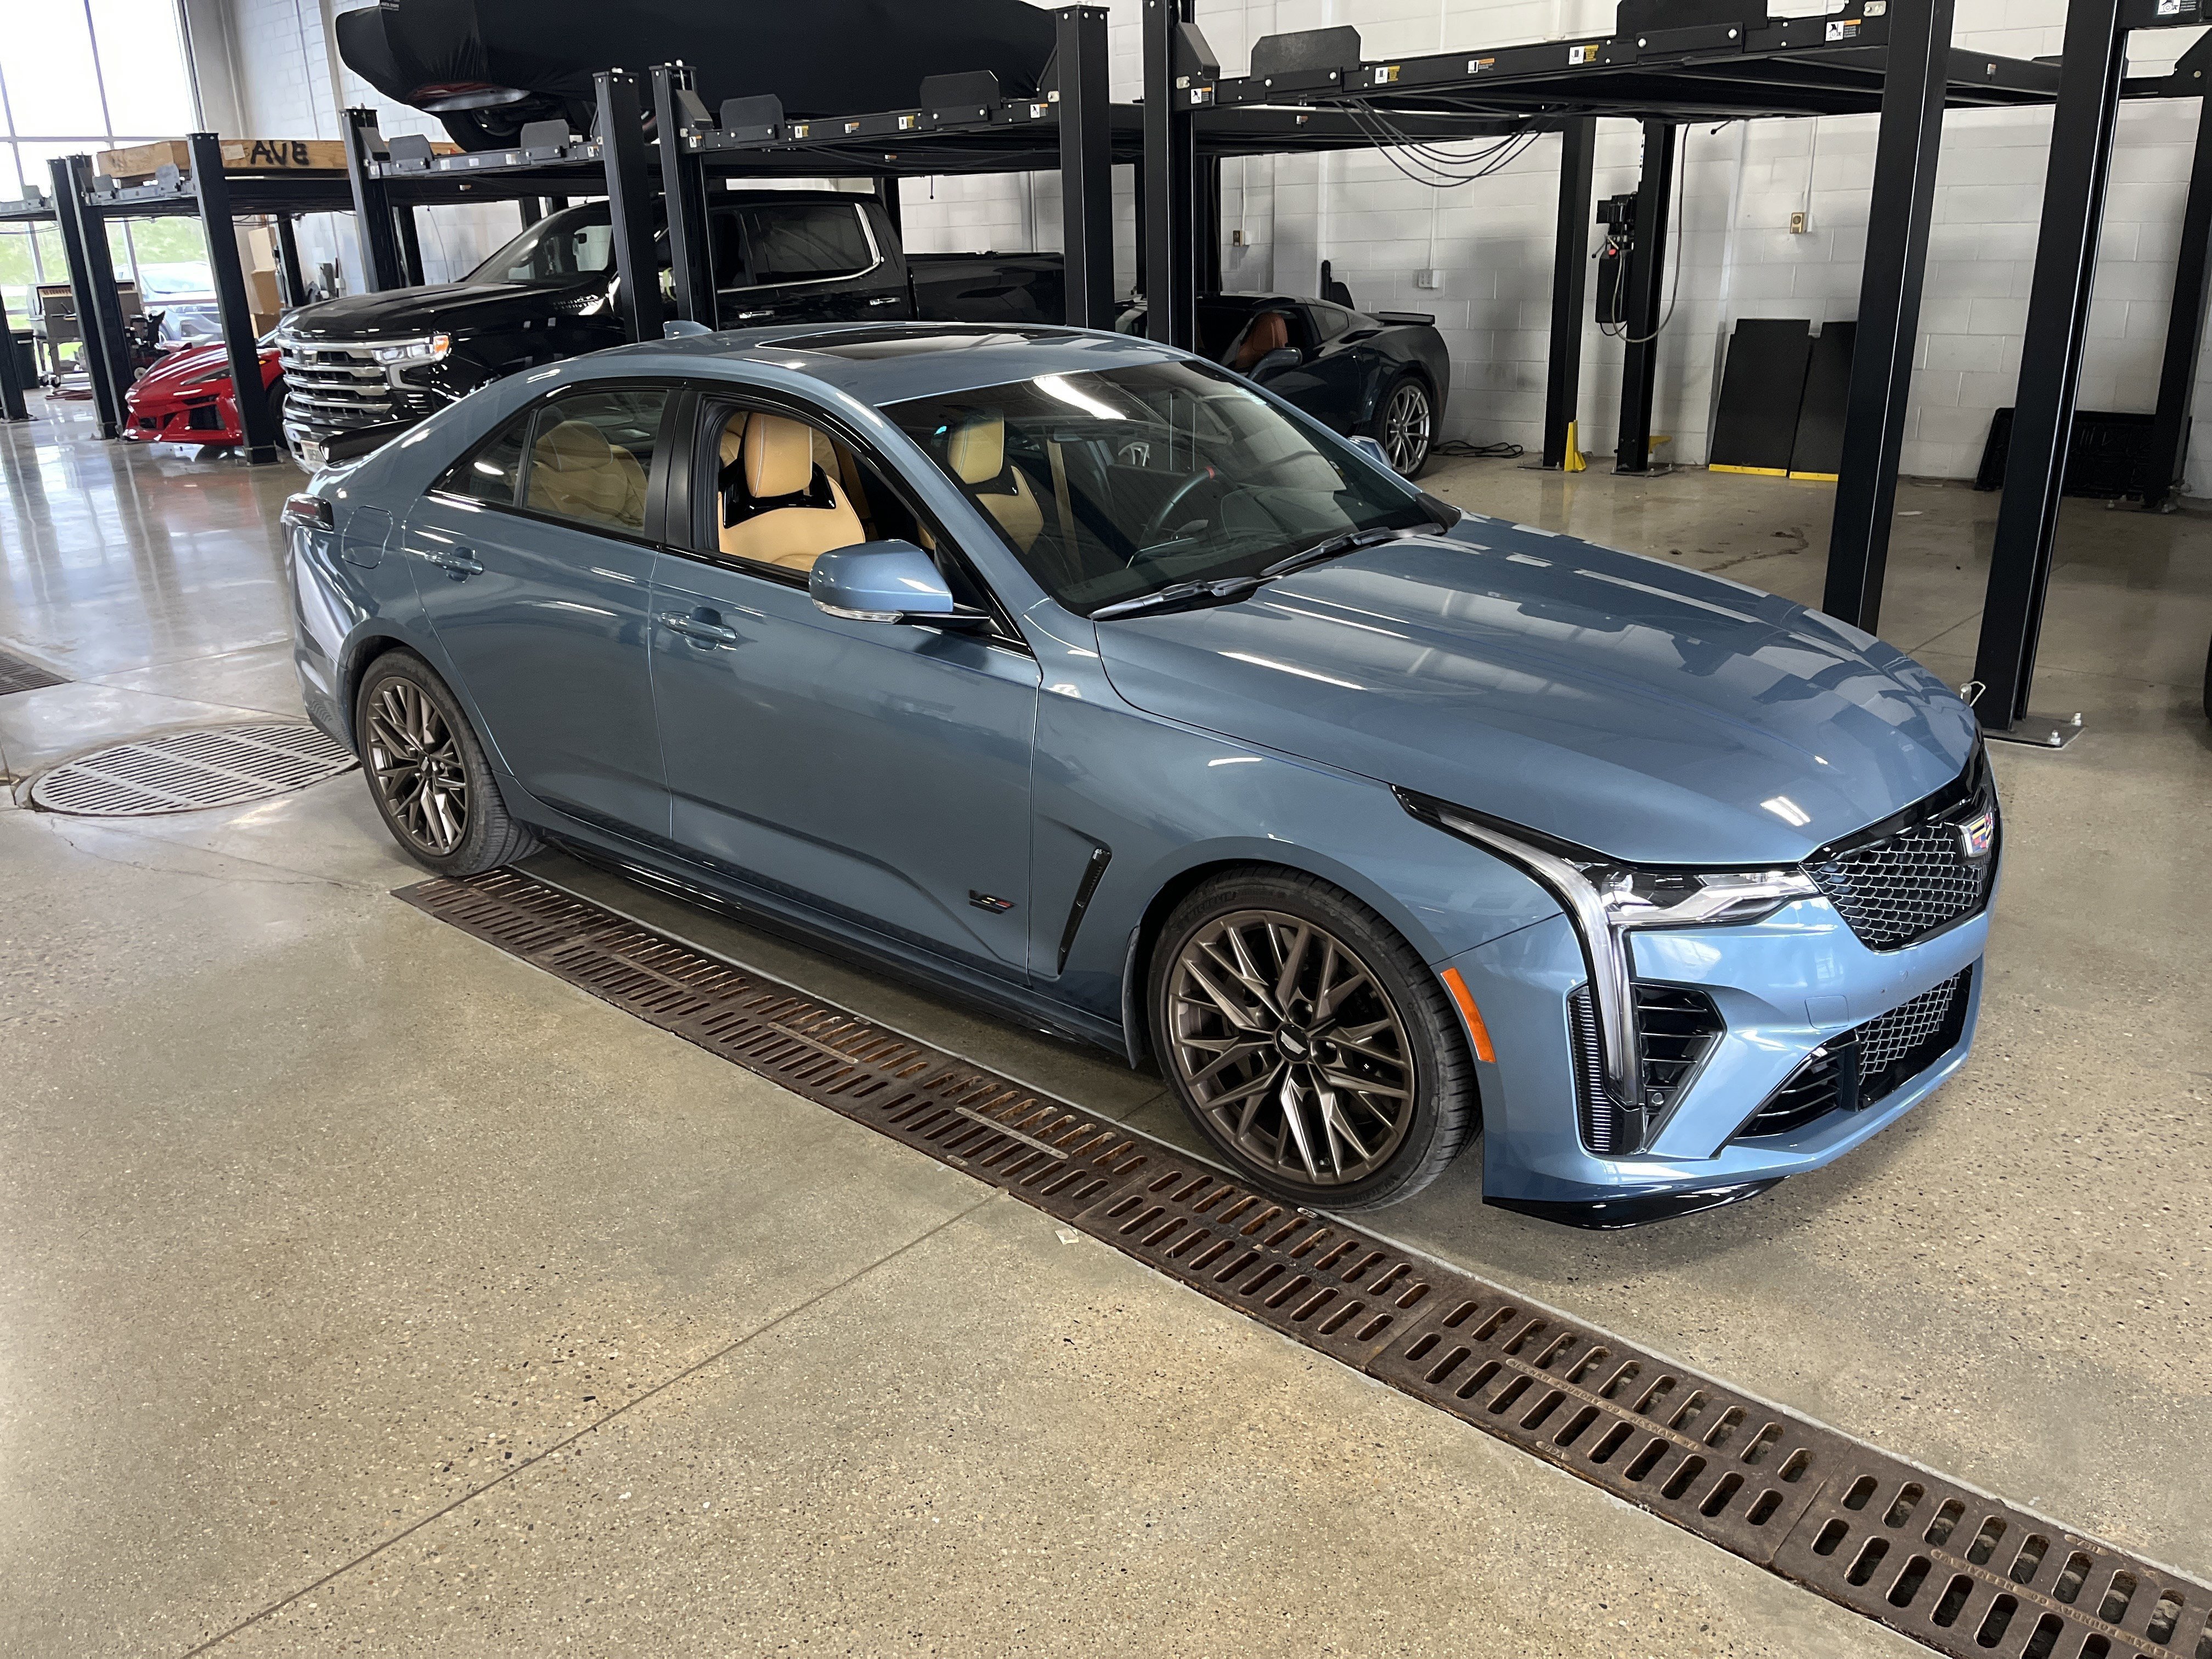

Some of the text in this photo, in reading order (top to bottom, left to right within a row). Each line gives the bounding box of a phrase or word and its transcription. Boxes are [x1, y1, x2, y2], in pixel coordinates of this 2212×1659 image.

[1555, 1380, 1601, 1406] FOUNDRY
[2075, 1538, 2100, 1554] USA
[2059, 1605, 2117, 1636] FOUNDRY
